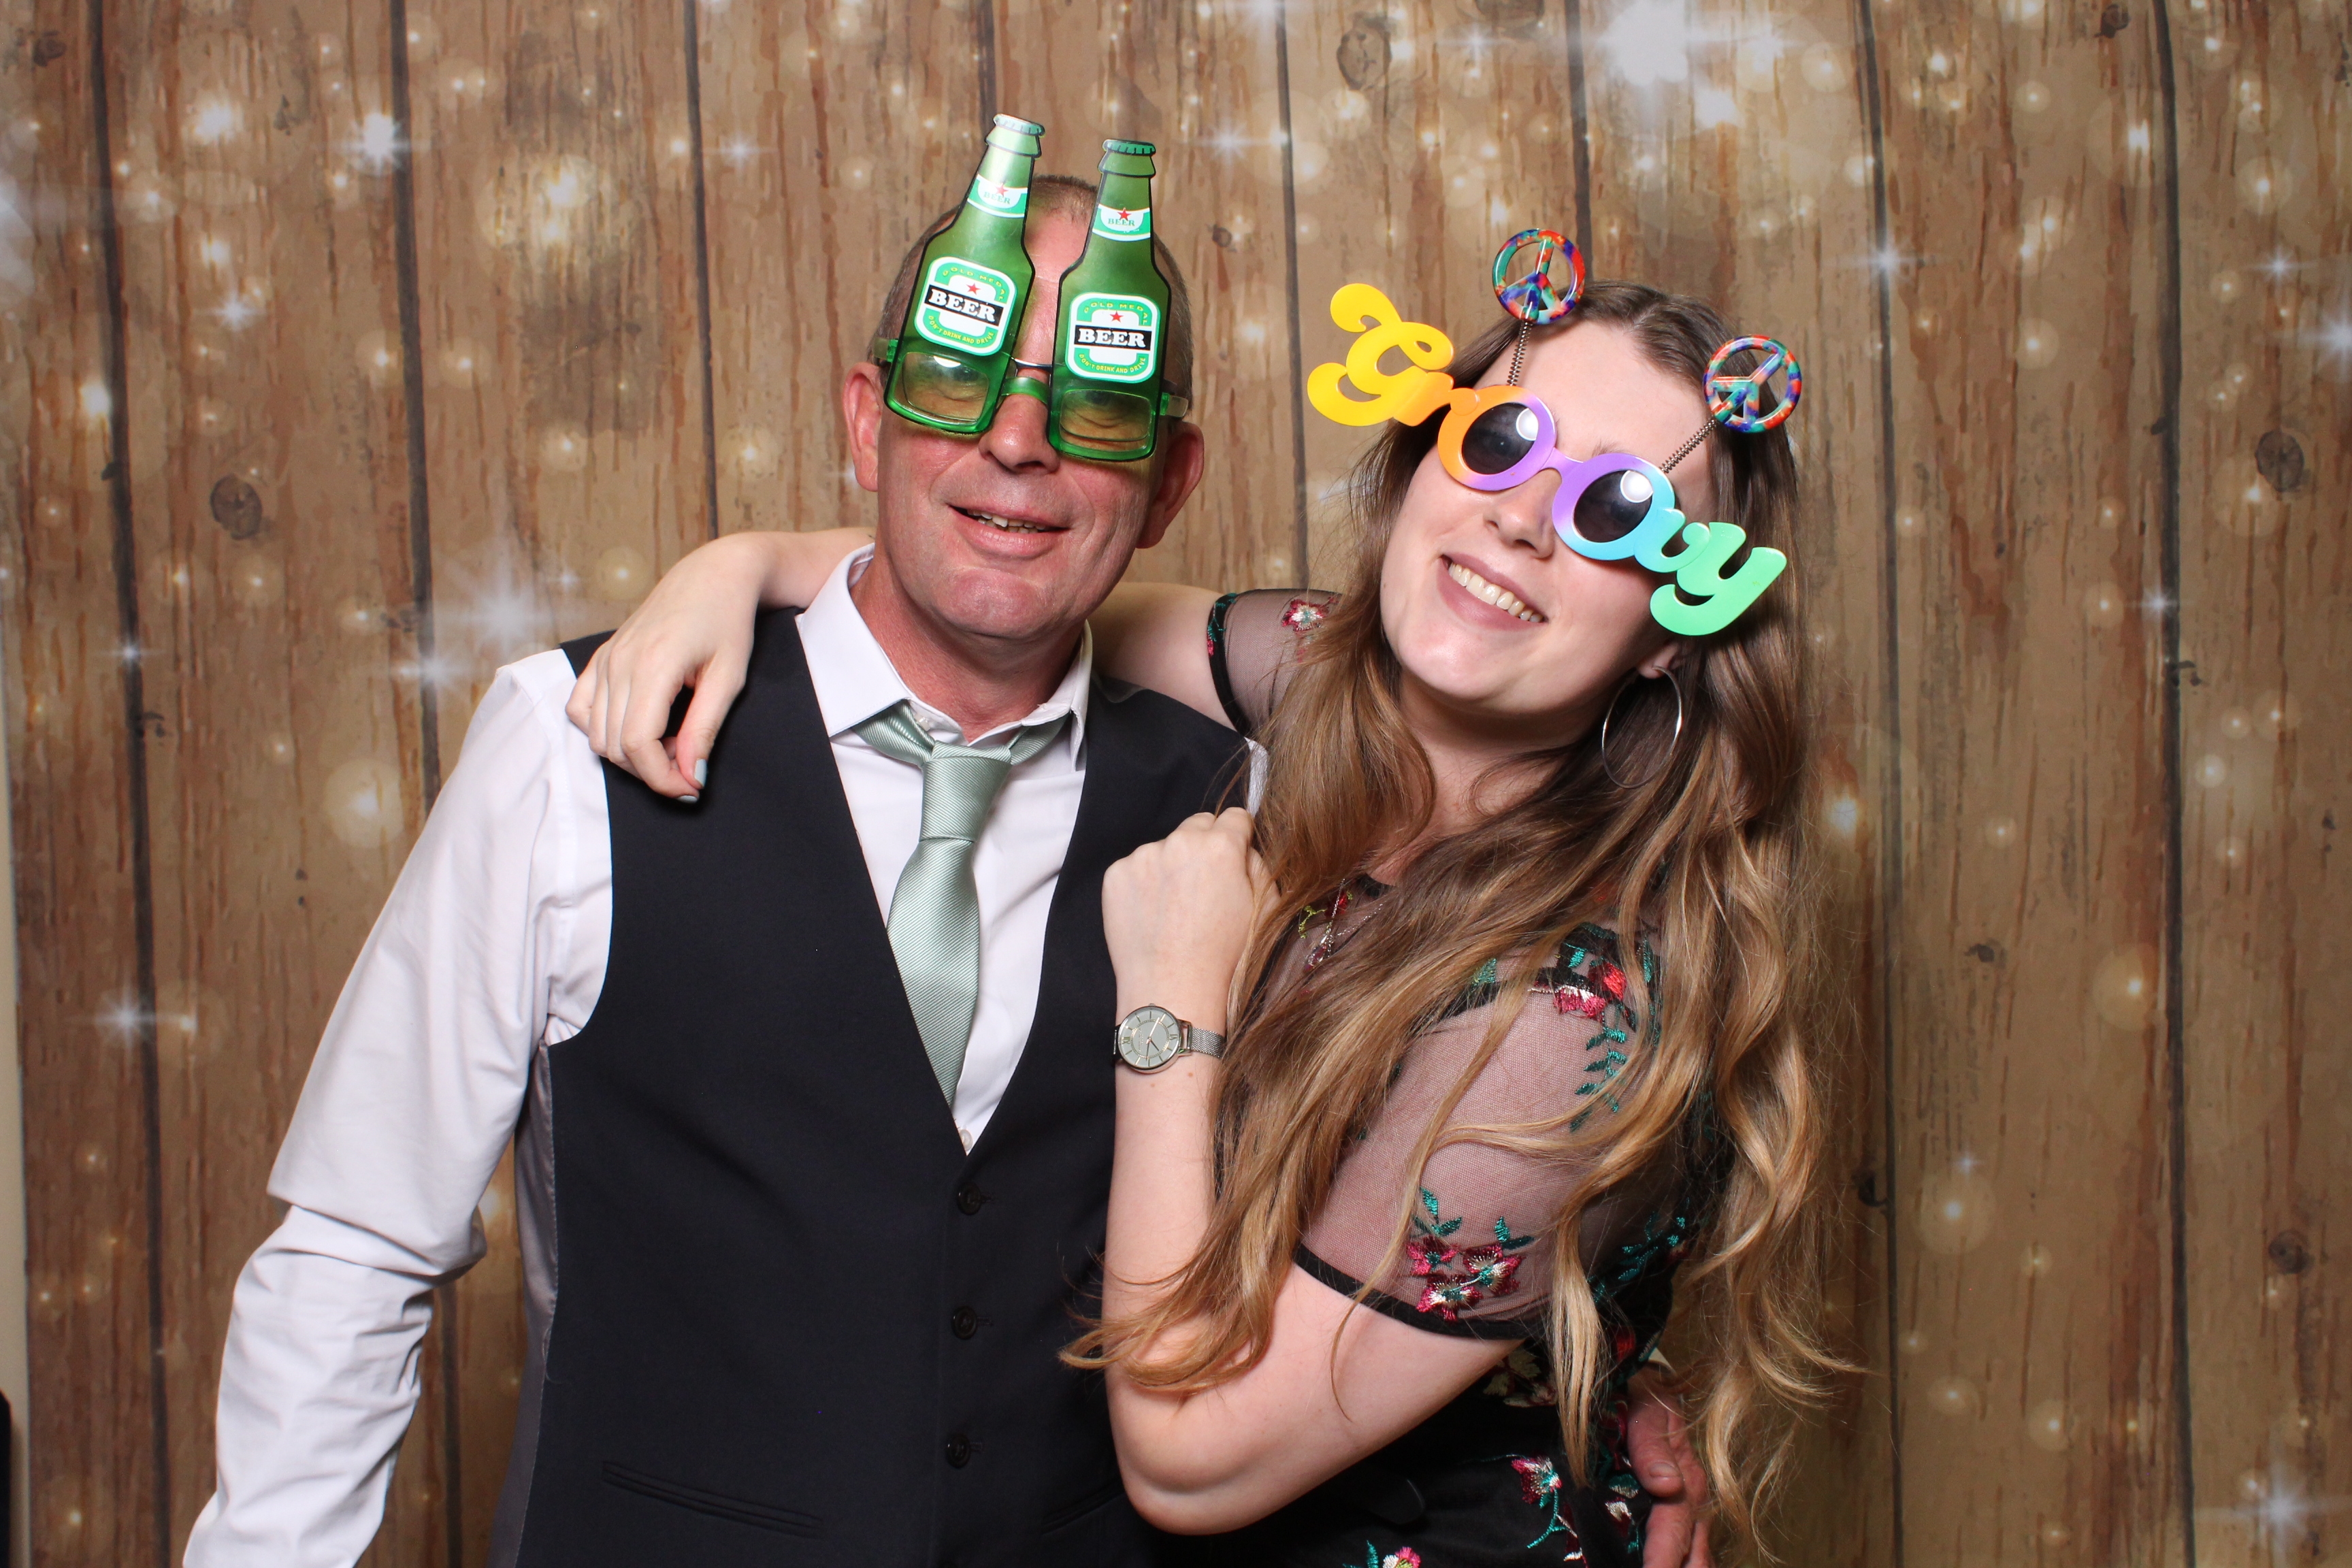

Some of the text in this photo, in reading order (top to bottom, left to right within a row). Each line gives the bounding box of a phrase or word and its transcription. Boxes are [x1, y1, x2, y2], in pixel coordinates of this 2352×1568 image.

[983, 191, 1011, 204] BEER
[1108, 218, 1135, 227] BEER
[943, 267, 1006, 301] GOLD MEDAL
[928, 288, 996, 323] BEER
[1084, 301, 1148, 325] GOLD MEDAL
[928, 315, 994, 344] DON'T DRINK AND DRIVE
[1077, 327, 1146, 348] BEER
[1079, 353, 1095, 370] DON'T
[1130, 357, 1146, 372] DRIVE
